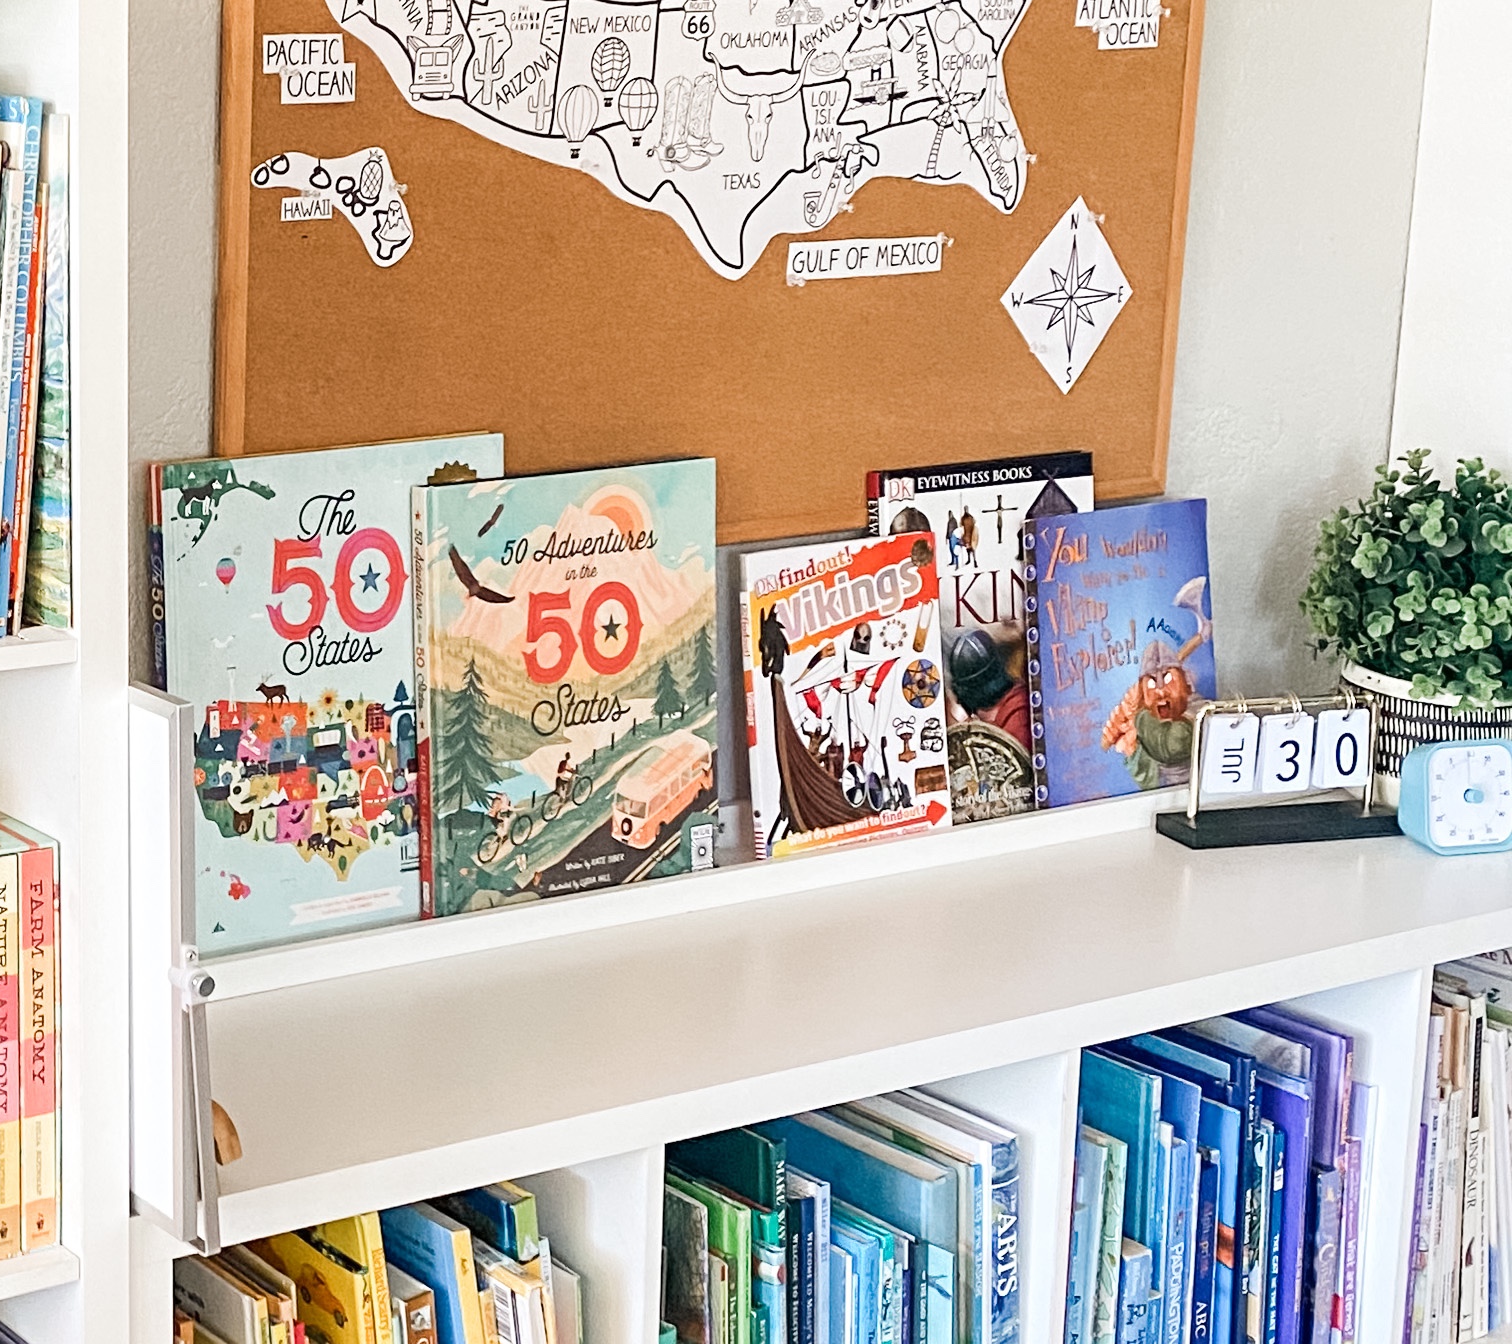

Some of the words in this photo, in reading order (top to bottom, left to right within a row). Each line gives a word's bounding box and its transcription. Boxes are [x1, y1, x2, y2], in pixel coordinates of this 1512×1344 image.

[570, 17, 600, 34] NEW
[604, 15, 651, 32] MEXICO
[687, 16, 710, 34] 66
[721, 31, 788, 49] OKLAHOMA
[799, 7, 858, 55] ARKANSAS
[1106, 23, 1157, 46] OCEAN
[266, 38, 340, 66] PACIFIC
[941, 54, 989, 73] GEORGIA
[287, 69, 354, 98] OCEAN
[494, 51, 557, 110] ARIZONA
[18, 125, 39, 265] CHRISTOPHER
[723, 174, 761, 190] TEXAS
[283, 199, 331, 217] HAWAII
[792, 249, 840, 274] GULF
[846, 246, 870, 269] OF
[876, 241, 938, 267] MEXICO
[10, 270, 30, 382] COLUMBUS
[889, 480, 912, 499] DK
[917, 471, 989, 490] EYEWITNESS
[993, 466, 1032, 482] BOOKS
[297, 489, 357, 541] The
[501, 539, 528, 566] 50
[533, 526, 658, 565] Adventures
[778, 545, 853, 589] findout!
[266, 527, 410, 639] 50
[775, 559, 923, 644] Vikings
[282, 626, 383, 676] States
[521, 581, 644, 684] 50
[531, 684, 631, 737] States
[1221, 738, 1245, 784] JUL
[30, 882, 45, 959] FARM
[31, 968, 45, 1084] ANATOMY
[1466, 1129, 1479, 1210] DINOSAUR
[996, 1212, 1018, 1297] ARTS
[1194, 1301, 1208, 1339] ABC
